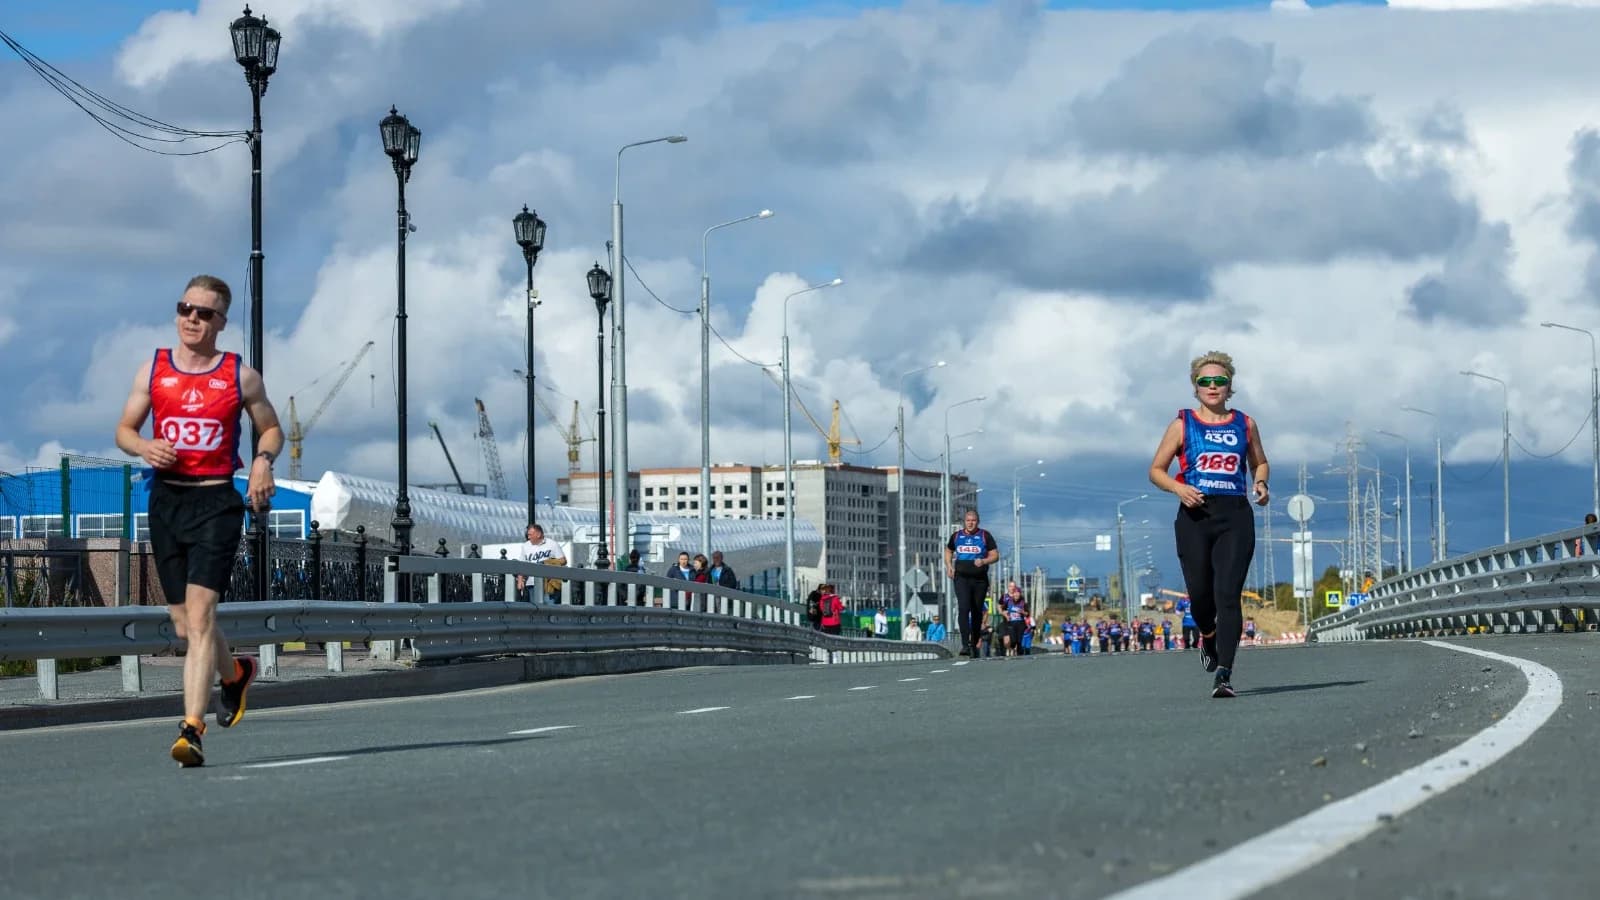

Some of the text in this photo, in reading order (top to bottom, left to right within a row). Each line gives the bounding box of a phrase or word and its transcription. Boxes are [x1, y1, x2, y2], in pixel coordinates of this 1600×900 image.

[163, 420, 221, 447] 037
[1204, 433, 1238, 446] 430
[1198, 454, 1238, 472] 168
